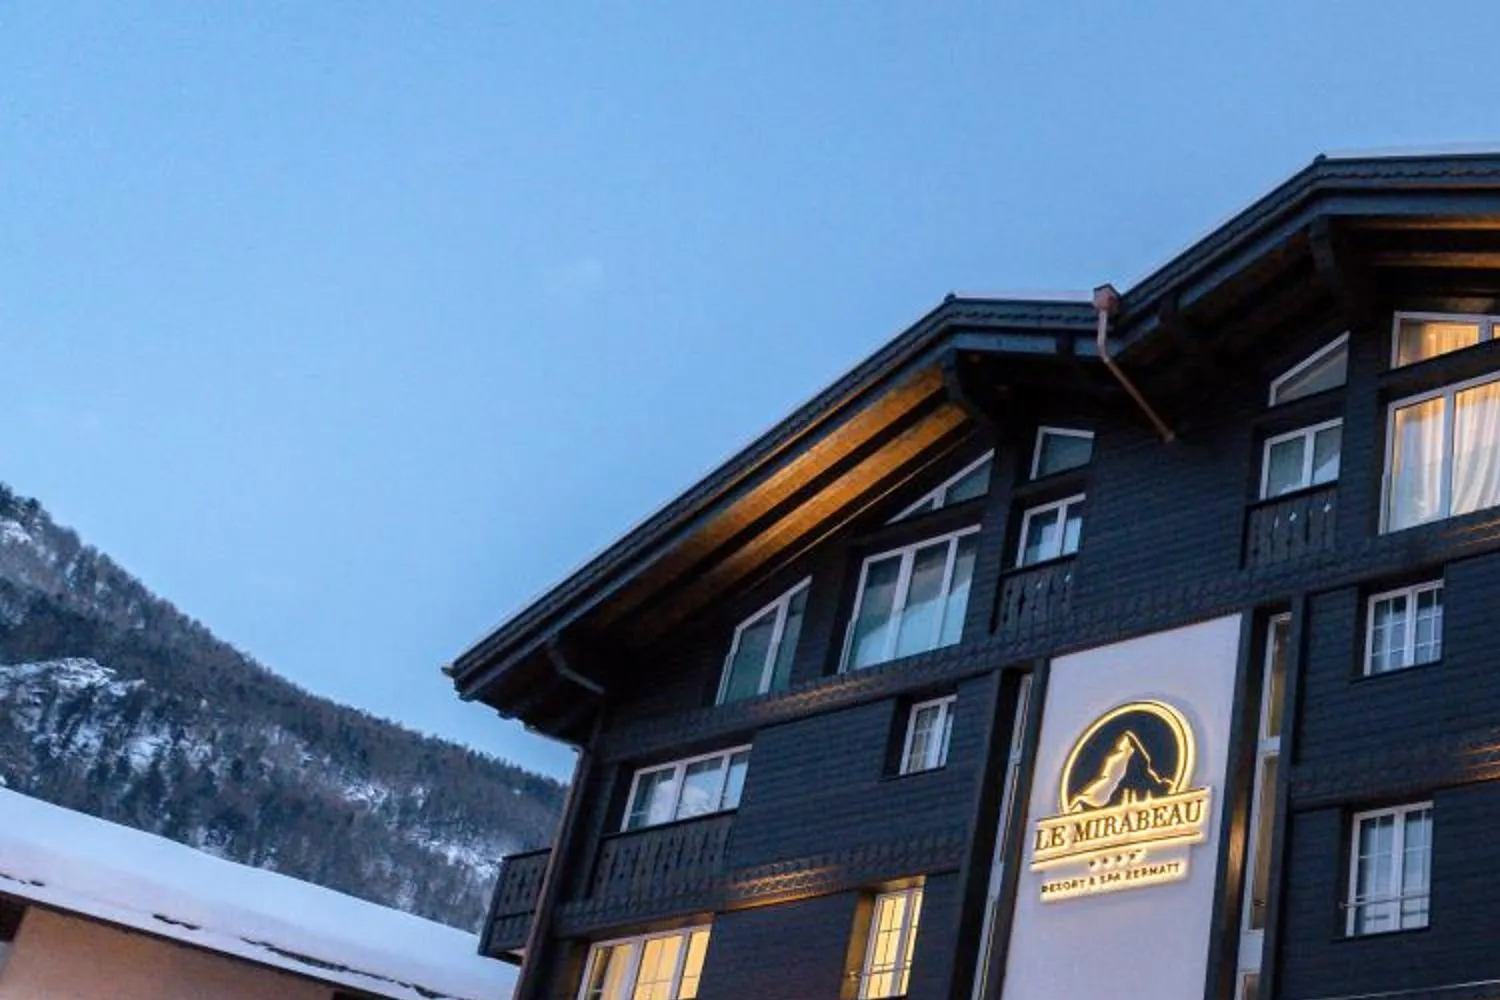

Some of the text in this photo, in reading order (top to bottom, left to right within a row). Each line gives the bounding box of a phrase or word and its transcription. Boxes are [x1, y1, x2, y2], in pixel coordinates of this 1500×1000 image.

[1036, 799, 1203, 850] LE MIRABEAU
[1041, 879, 1085, 893] RESORT
[1099, 871, 1121, 884] SPA
[1125, 863, 1181, 881] ZERMATT
